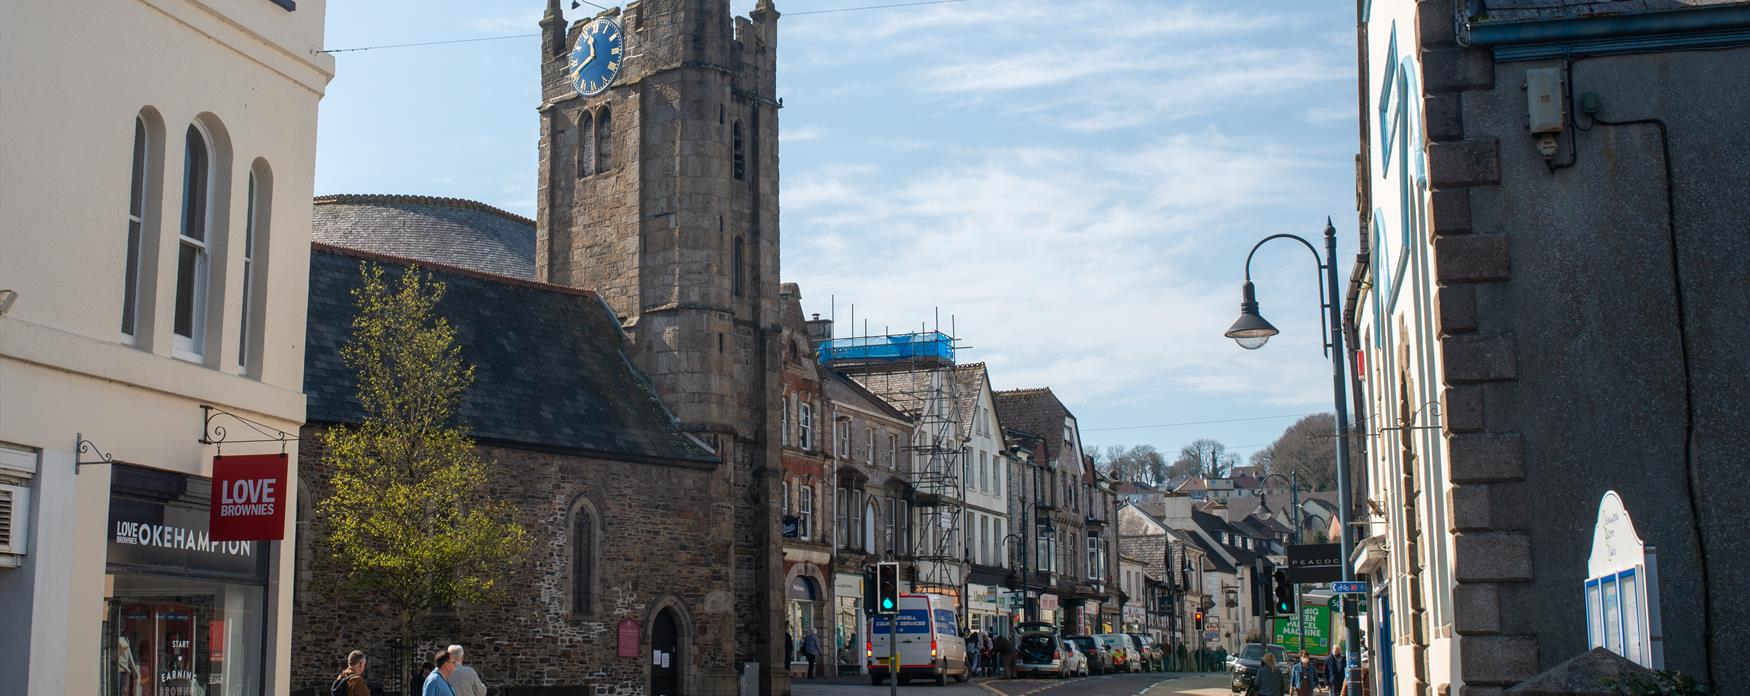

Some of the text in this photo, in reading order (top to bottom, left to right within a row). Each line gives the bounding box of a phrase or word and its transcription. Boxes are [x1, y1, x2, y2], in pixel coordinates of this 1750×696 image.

[221, 478, 277, 505] LOVE
[220, 503, 275, 517] BROWNIES
[117, 520, 139, 537] LOVE
[116, 535, 138, 545] BROWNIES
[1287, 620, 1318, 630] PACEL
[172, 640, 190, 648] START
